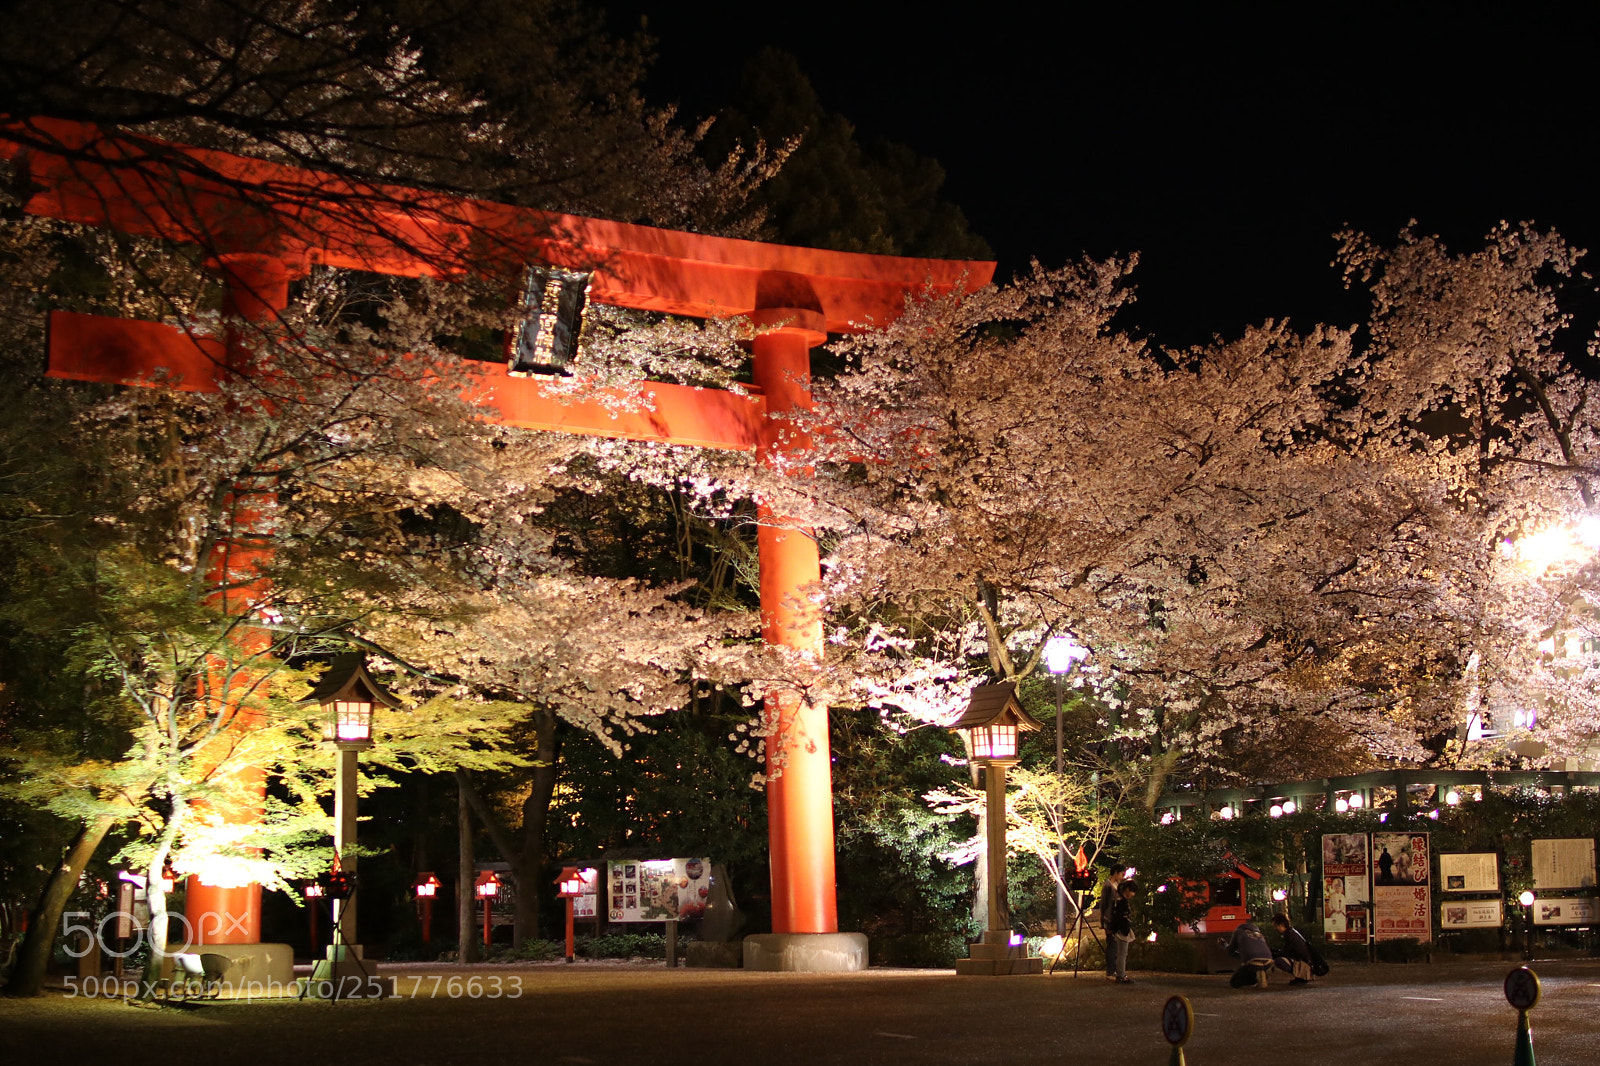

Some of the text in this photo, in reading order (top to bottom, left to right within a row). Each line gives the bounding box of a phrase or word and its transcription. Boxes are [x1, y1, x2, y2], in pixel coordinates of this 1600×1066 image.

[1411, 836, 1427, 917] 縁結び 婚活
